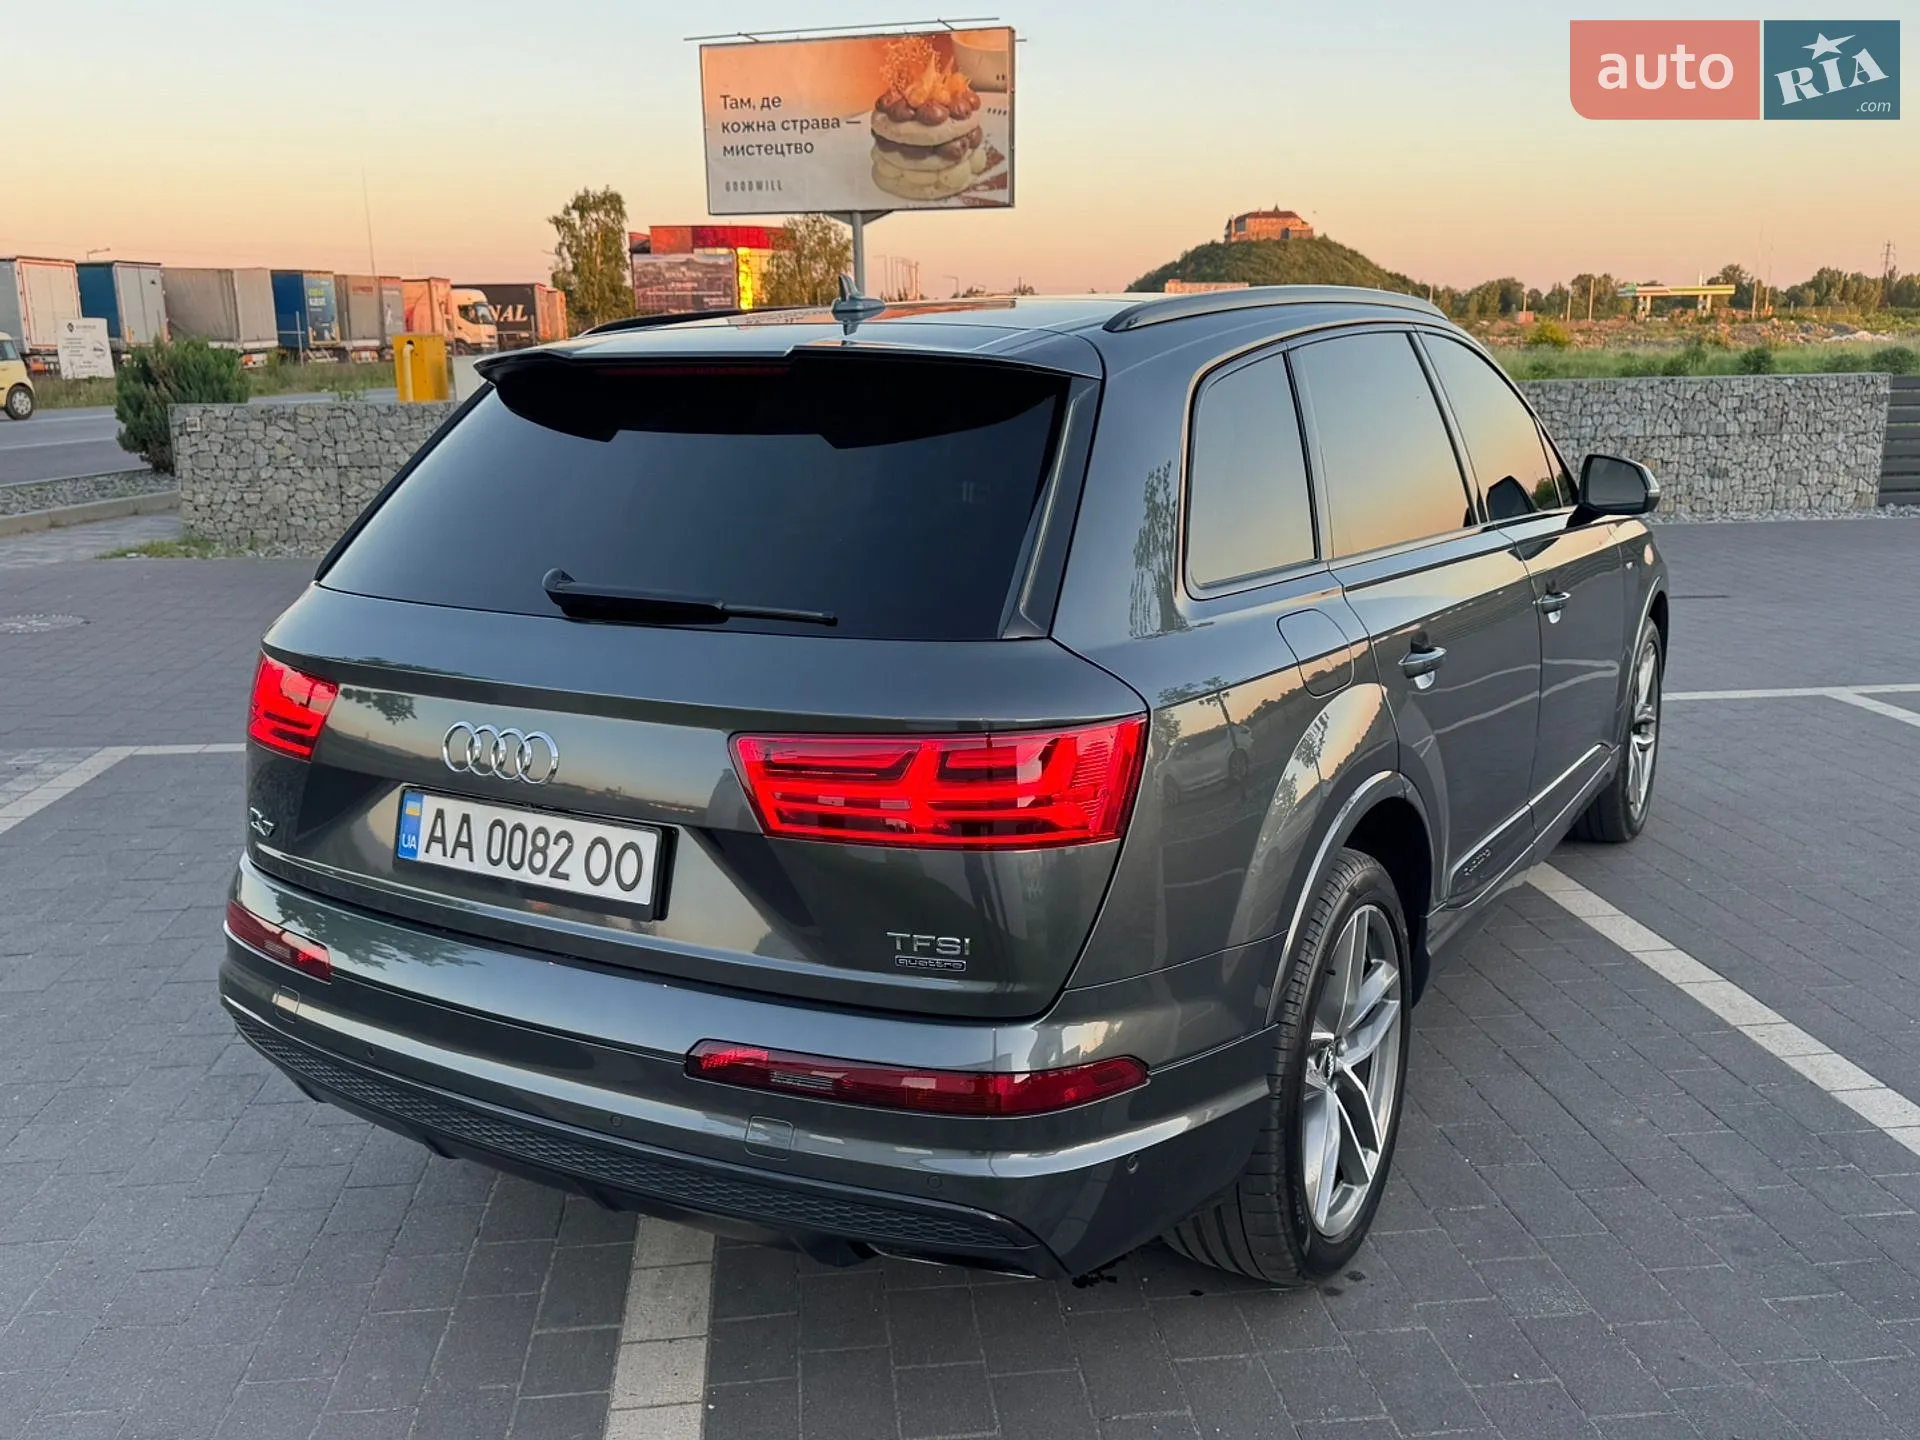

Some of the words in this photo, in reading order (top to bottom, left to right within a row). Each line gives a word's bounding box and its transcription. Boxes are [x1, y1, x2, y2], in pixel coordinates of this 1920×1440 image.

[720, 95, 756, 110] Там,
[760, 95, 782, 110] де
[721, 120, 776, 133] кожна
[781, 117, 841, 134] страва
[723, 142, 815, 158] мистецтво
[401, 833, 417, 849] UA
[425, 808, 474, 863] AA
[486, 819, 574, 881] 0082
[886, 931, 970, 956] TFSI
